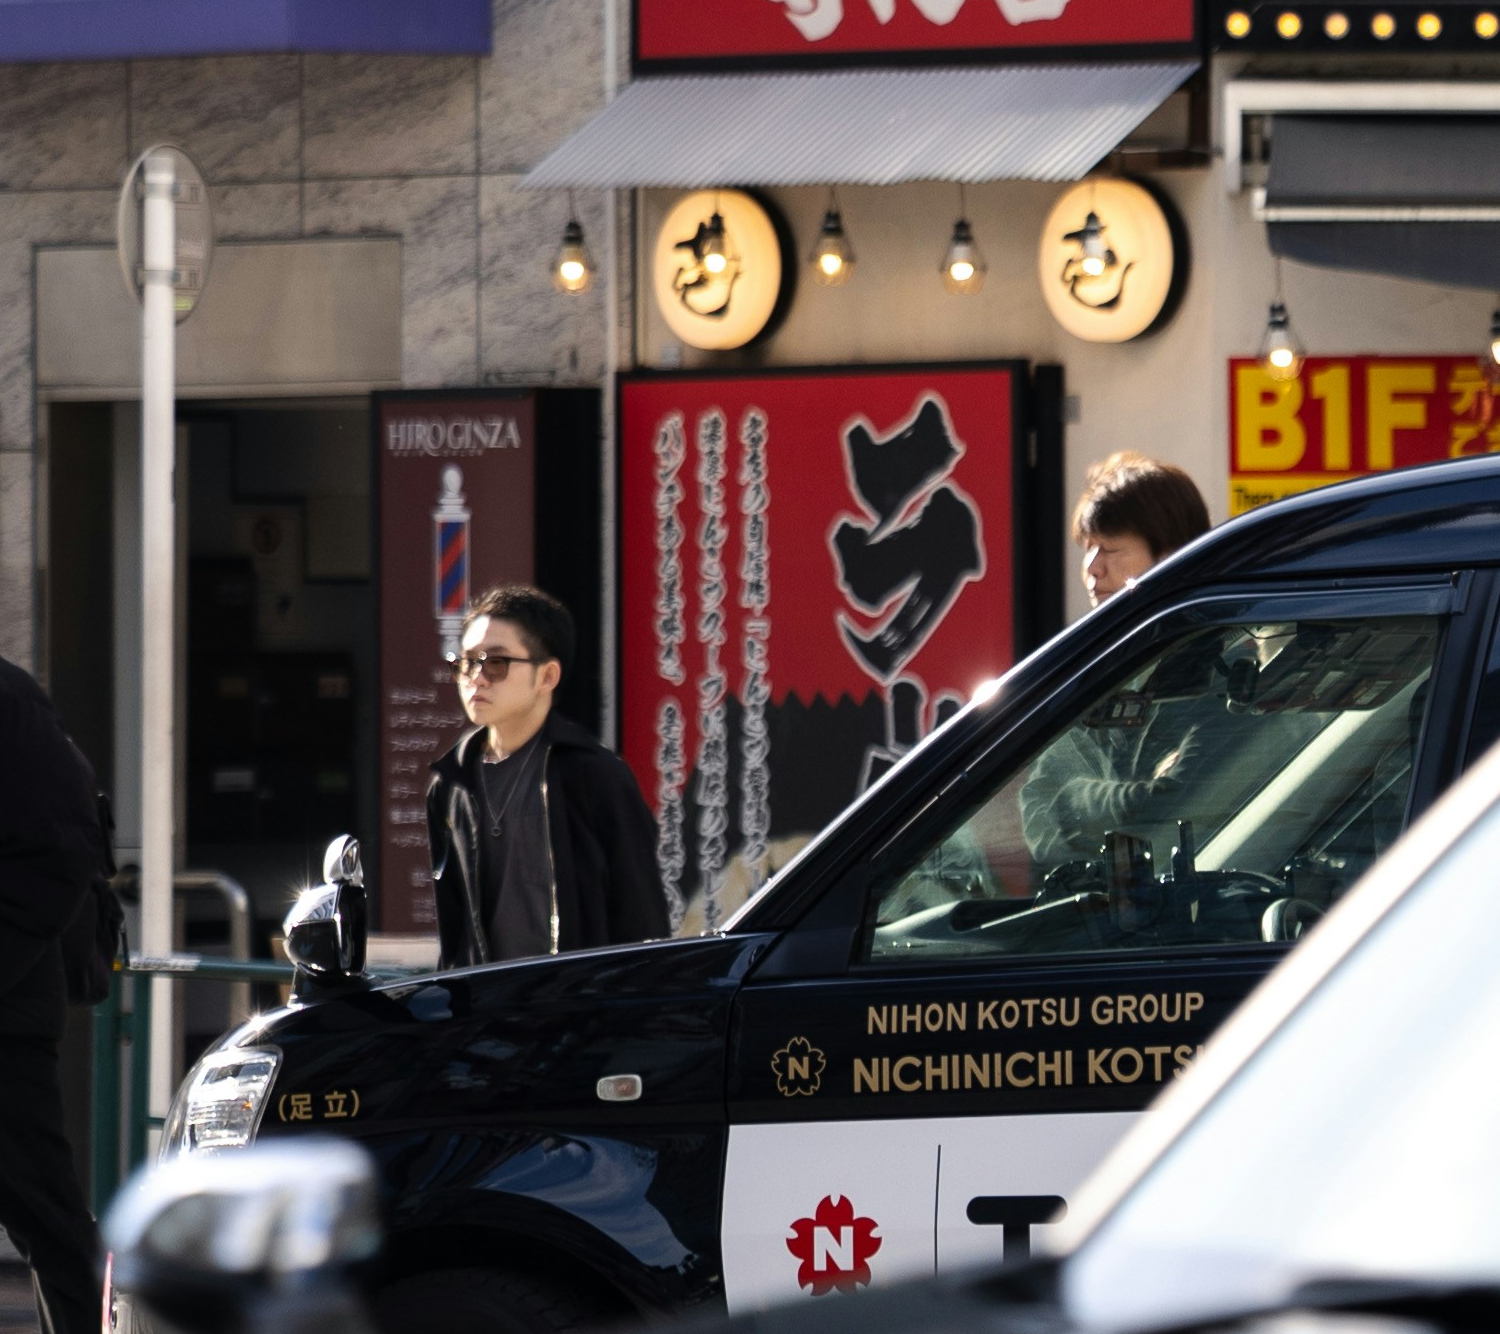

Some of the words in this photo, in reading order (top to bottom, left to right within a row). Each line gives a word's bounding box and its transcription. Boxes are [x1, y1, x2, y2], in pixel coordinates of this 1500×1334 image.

[1237, 364, 1437, 471] B1F
[867, 1002, 967, 1035] NIHON
[977, 997, 1080, 1030] KOTSU
[1090, 992, 1205, 1026] GROUP
[788, 1056, 810, 1080] N
[853, 1050, 1074, 1093] NICHINICHI
[1087, 1044, 1203, 1084] KOTS
[813, 1225, 854, 1272] N
